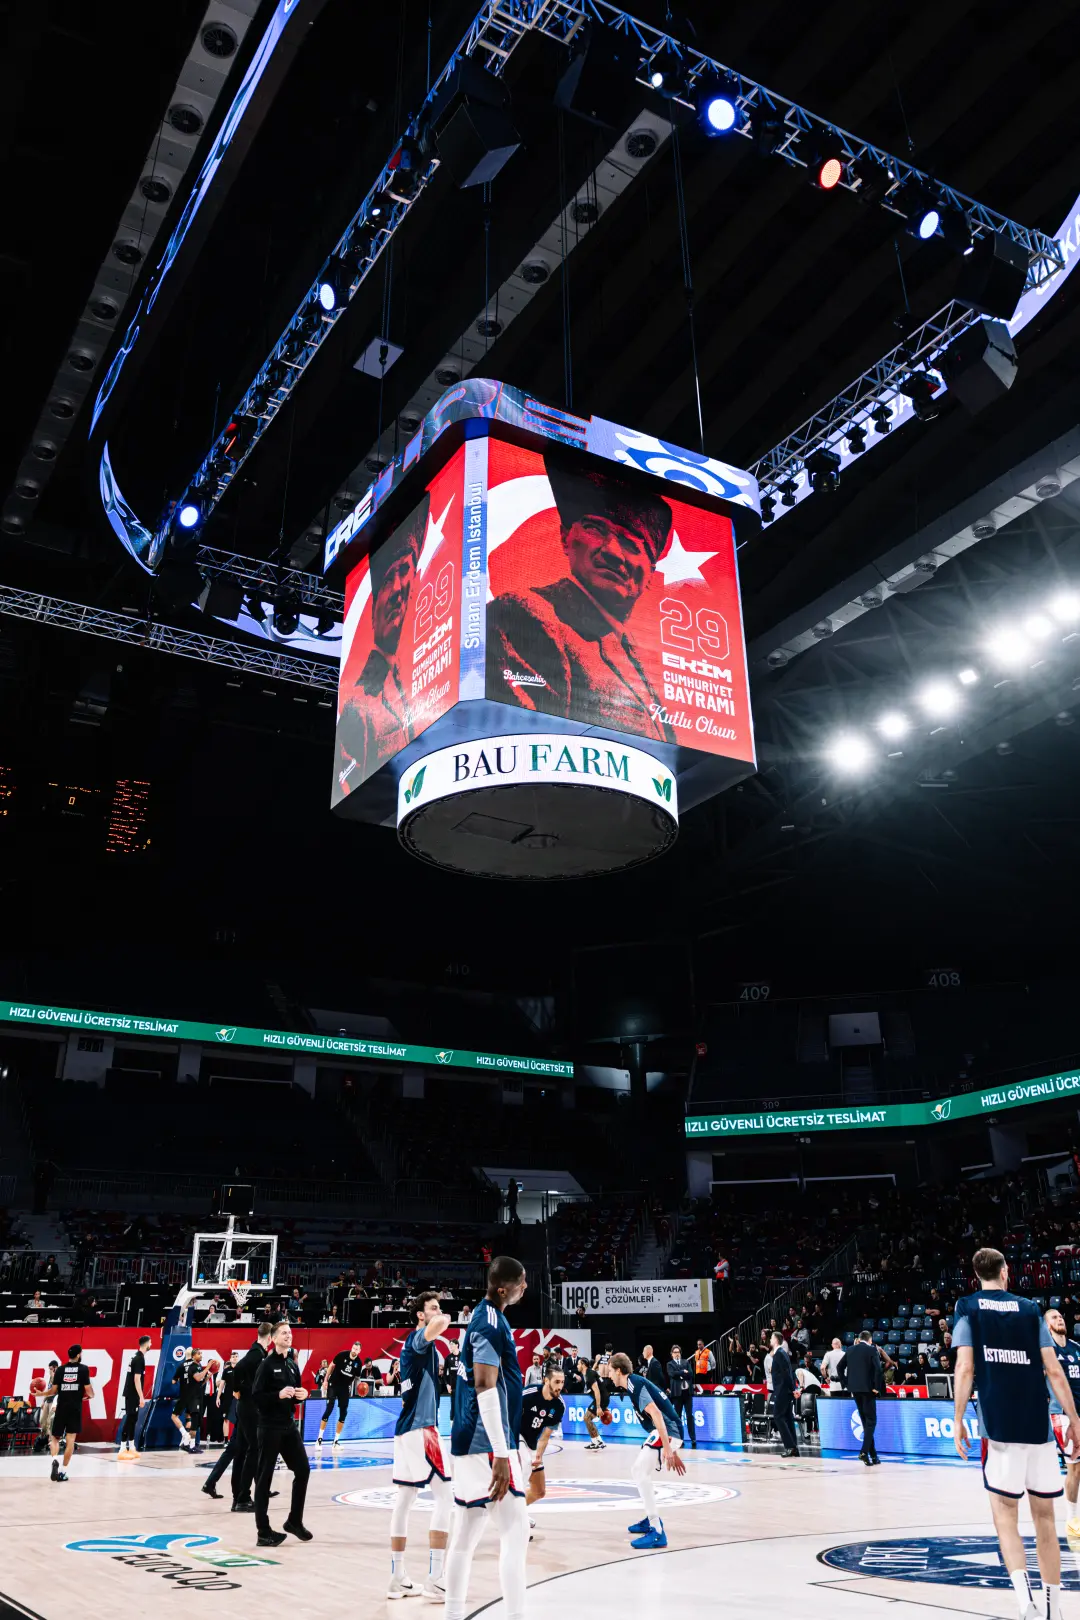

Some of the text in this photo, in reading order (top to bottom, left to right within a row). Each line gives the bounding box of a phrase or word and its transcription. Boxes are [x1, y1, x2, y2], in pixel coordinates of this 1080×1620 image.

[465, 546, 481, 597] Erdem
[414, 561, 455, 644] 29
[413, 616, 453, 665] EKİM
[464, 601, 481, 649] Sinan
[659, 597, 730, 660] 29
[411, 648, 452, 699] BAYRAMI
[412, 635, 452, 681] CUMHURİYET
[662, 651, 732, 683] EKİM
[663, 670, 733, 698] CUMHURİYET
[663, 684, 736, 717] BAYRAMI
[649, 703, 737, 741] Kutlu Olsun
[452, 744, 632, 783] BAU FARM
[739, 986, 770, 1001] 409
[927, 972, 961, 988] 408
[9, 1006, 179, 1033] HIZLI GÜVENLİ ÜCRETSİZ TESLİMAT
[263, 1034, 407, 1057] HIZLI GÜVENLİ ÜCRETSİZ TESLİMAT
[476, 1056, 495, 1066] HIZLI
[496, 1058, 530, 1069] GÜVENLİ
[530, 1061, 565, 1073] ÜCRETSİZ
[981, 1076, 1080, 1107] HIZLI GÜVENLİ ÜCR
[710, 1116, 764, 1131] GÜVENLİ
[766, 1113, 825, 1128] ÜCRETSİZ
[827, 1109, 887, 1125] TESLİMAT
[605, 1285, 688, 1294] ETKİNLİK VE SEYAHAT
[605, 1294, 654, 1305] ÇÖZÜMLERİ
[983, 1344, 1031, 1365] İSTANBUL
[1068, 1364, 1080, 1378] 22
[111, 1552, 243, 1592] EuroCup
